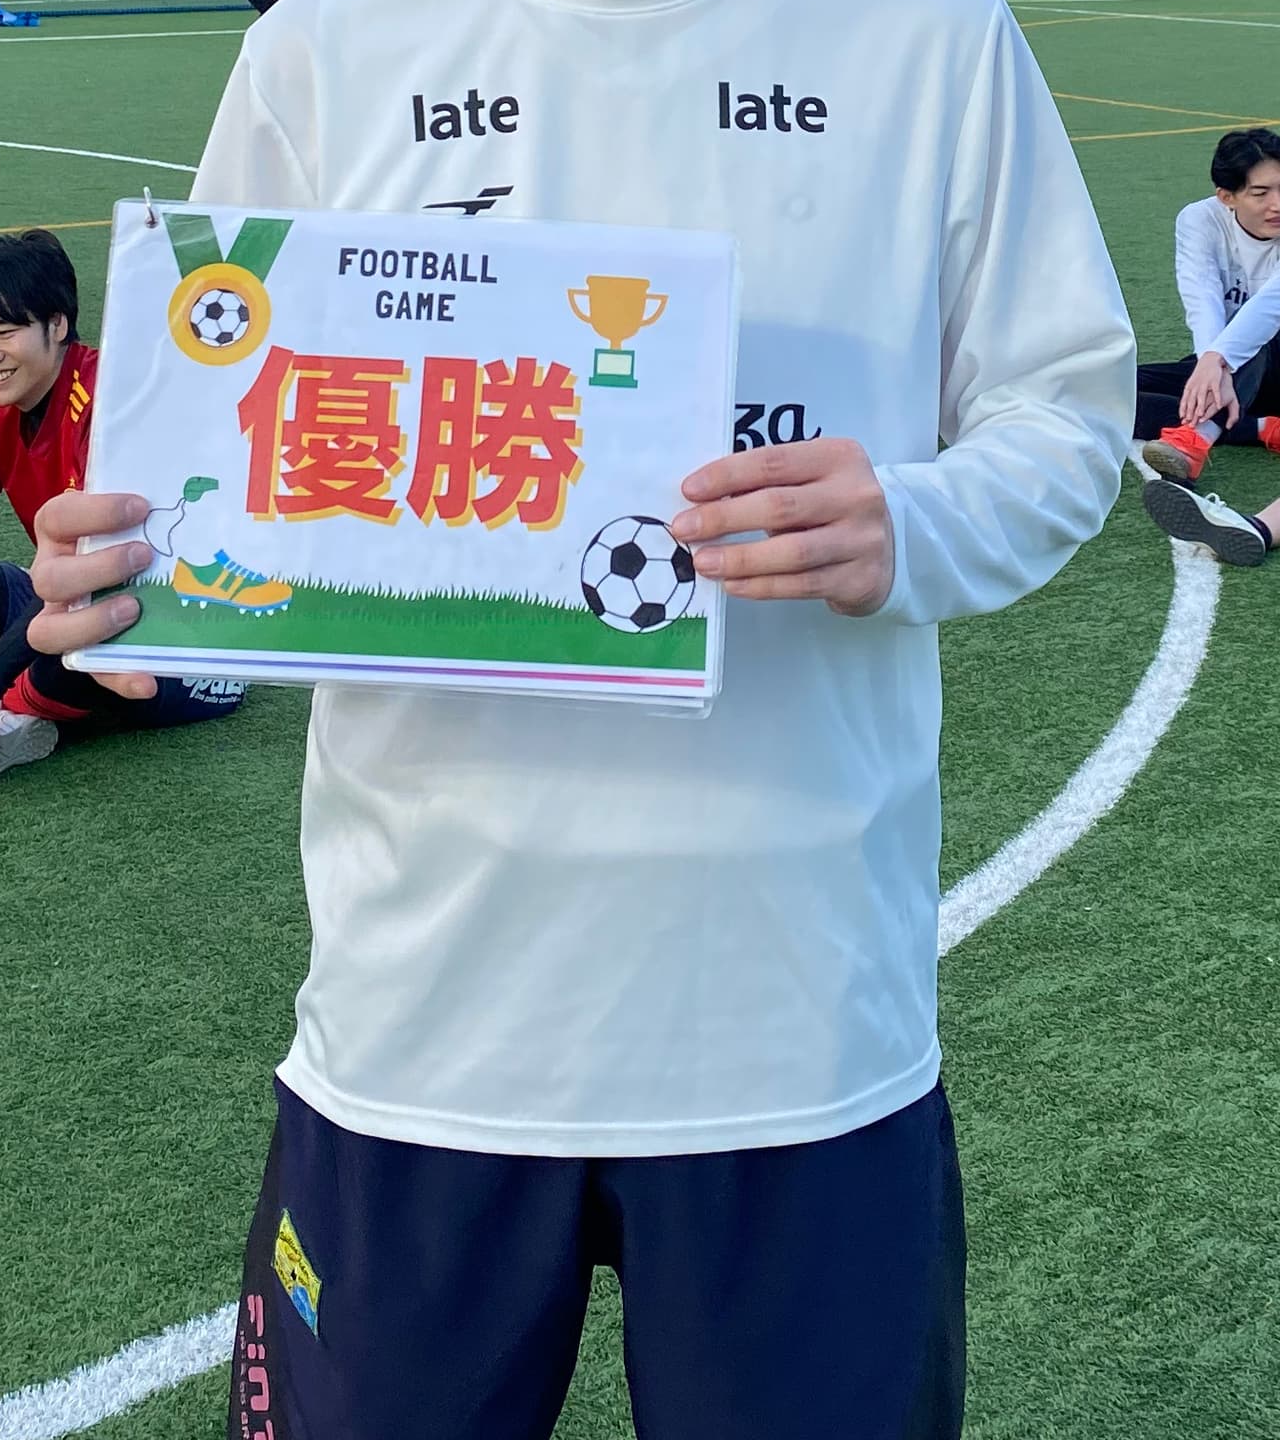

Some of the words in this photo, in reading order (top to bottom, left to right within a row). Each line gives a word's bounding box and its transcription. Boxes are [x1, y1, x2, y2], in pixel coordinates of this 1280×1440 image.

[412, 88, 520, 142] late
[718, 81, 828, 133] late
[338, 247, 498, 283] FOOTBALL
[375, 290, 456, 322] GAME
[236, 344, 585, 532] 優勝
